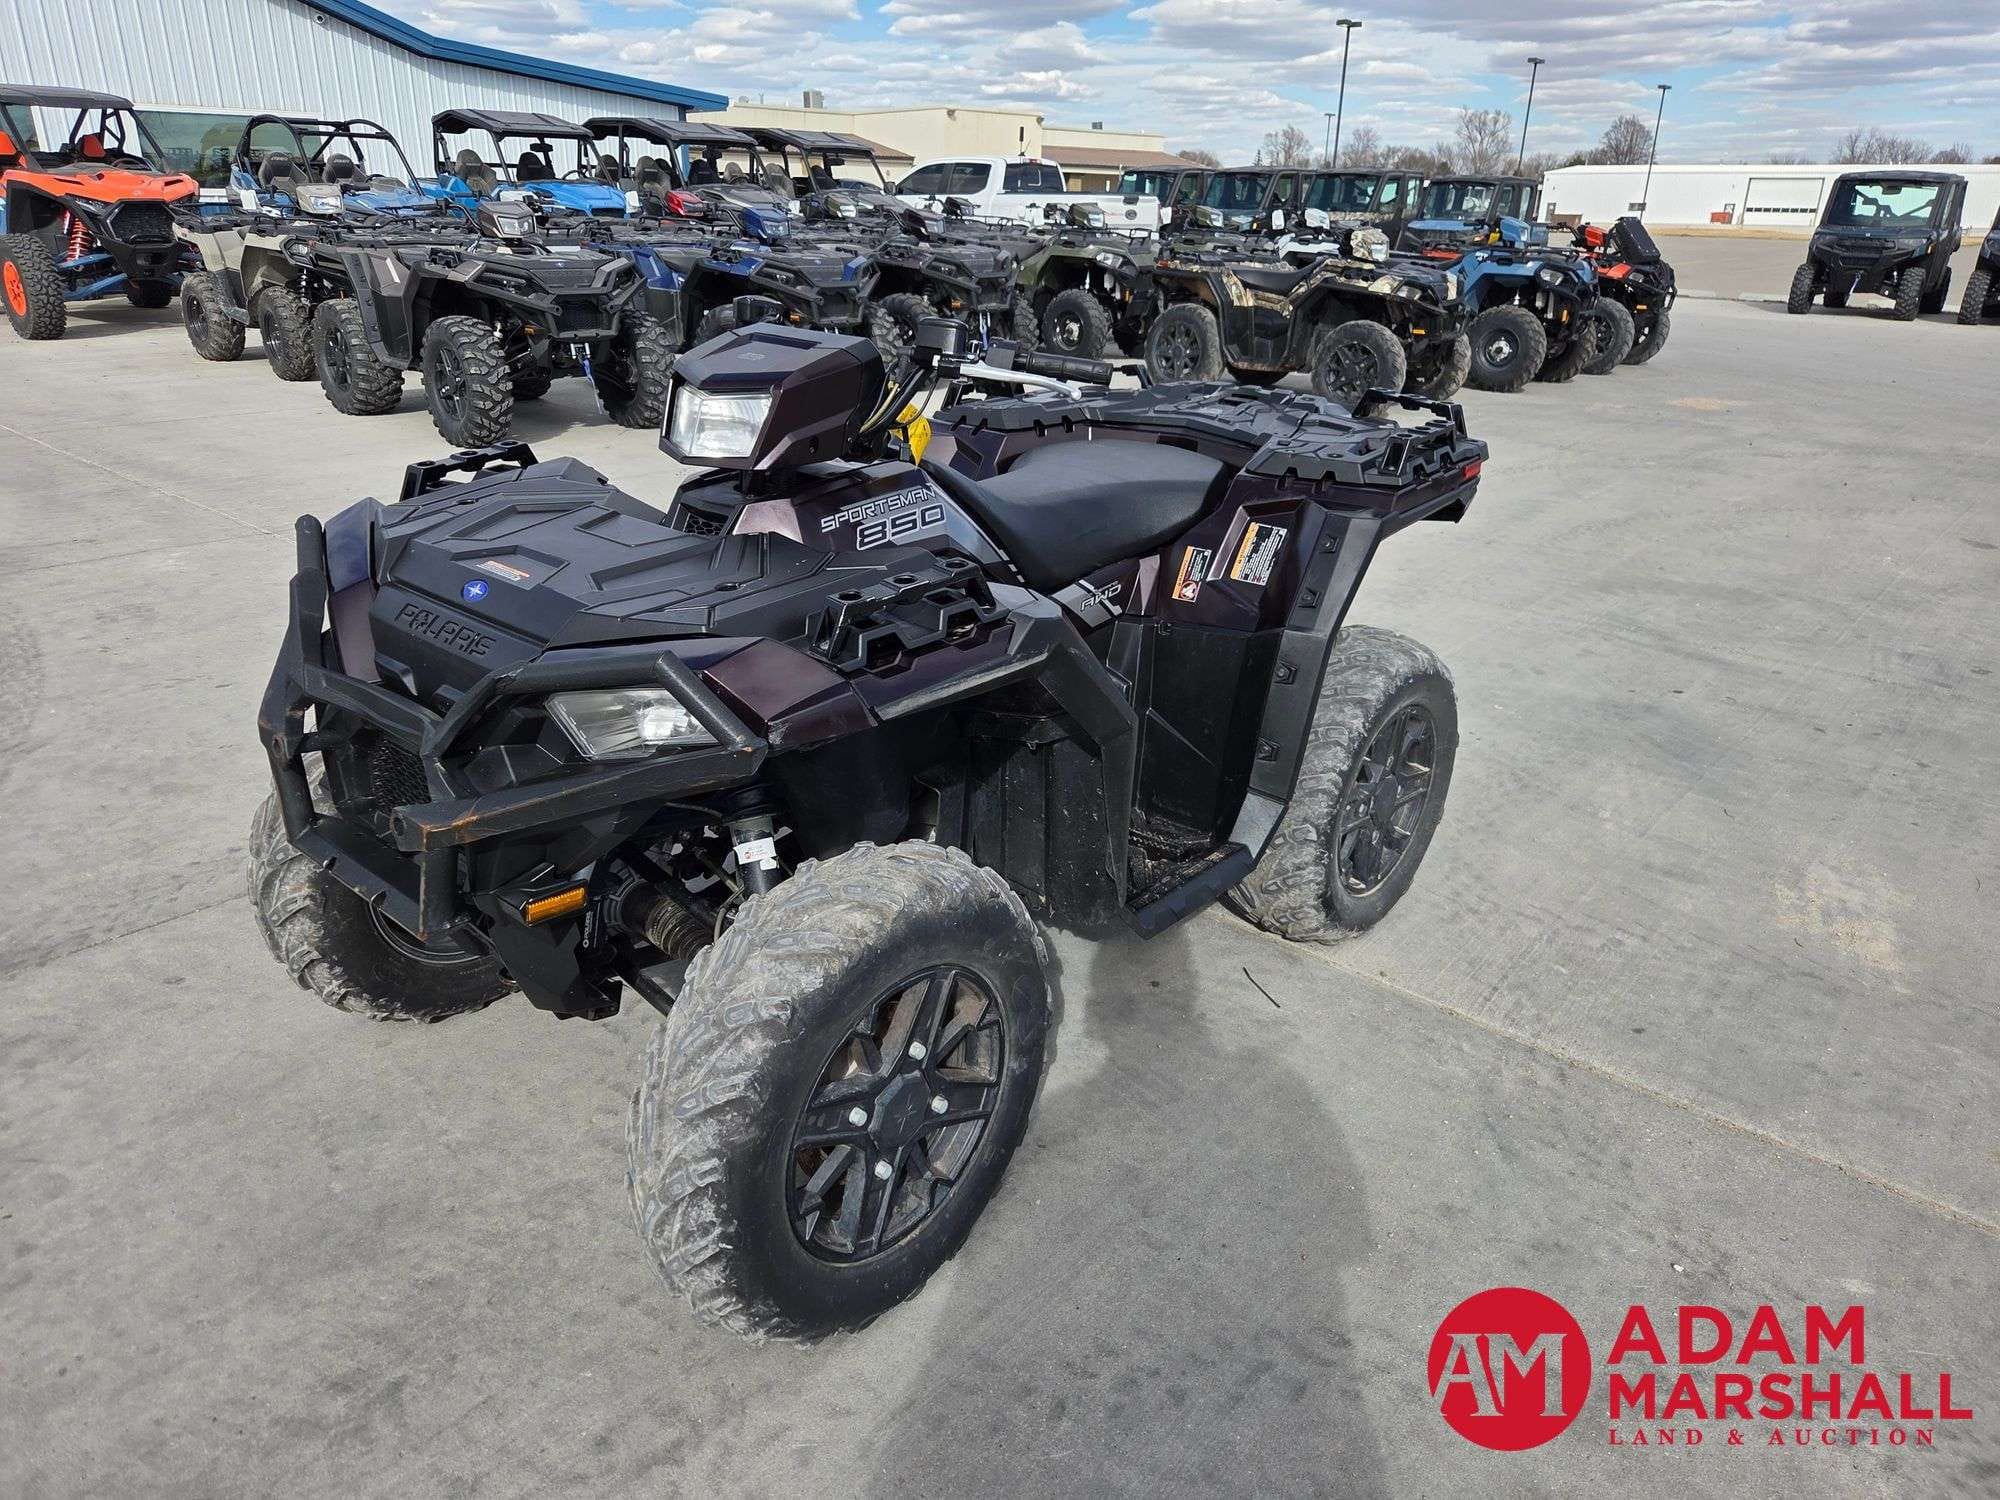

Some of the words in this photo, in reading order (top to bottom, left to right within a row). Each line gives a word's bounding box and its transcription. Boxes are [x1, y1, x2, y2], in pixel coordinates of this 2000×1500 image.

[820, 486, 938, 533] SPORTSMAN
[856, 502, 947, 551] 850
[393, 602, 497, 656] POLARIS
